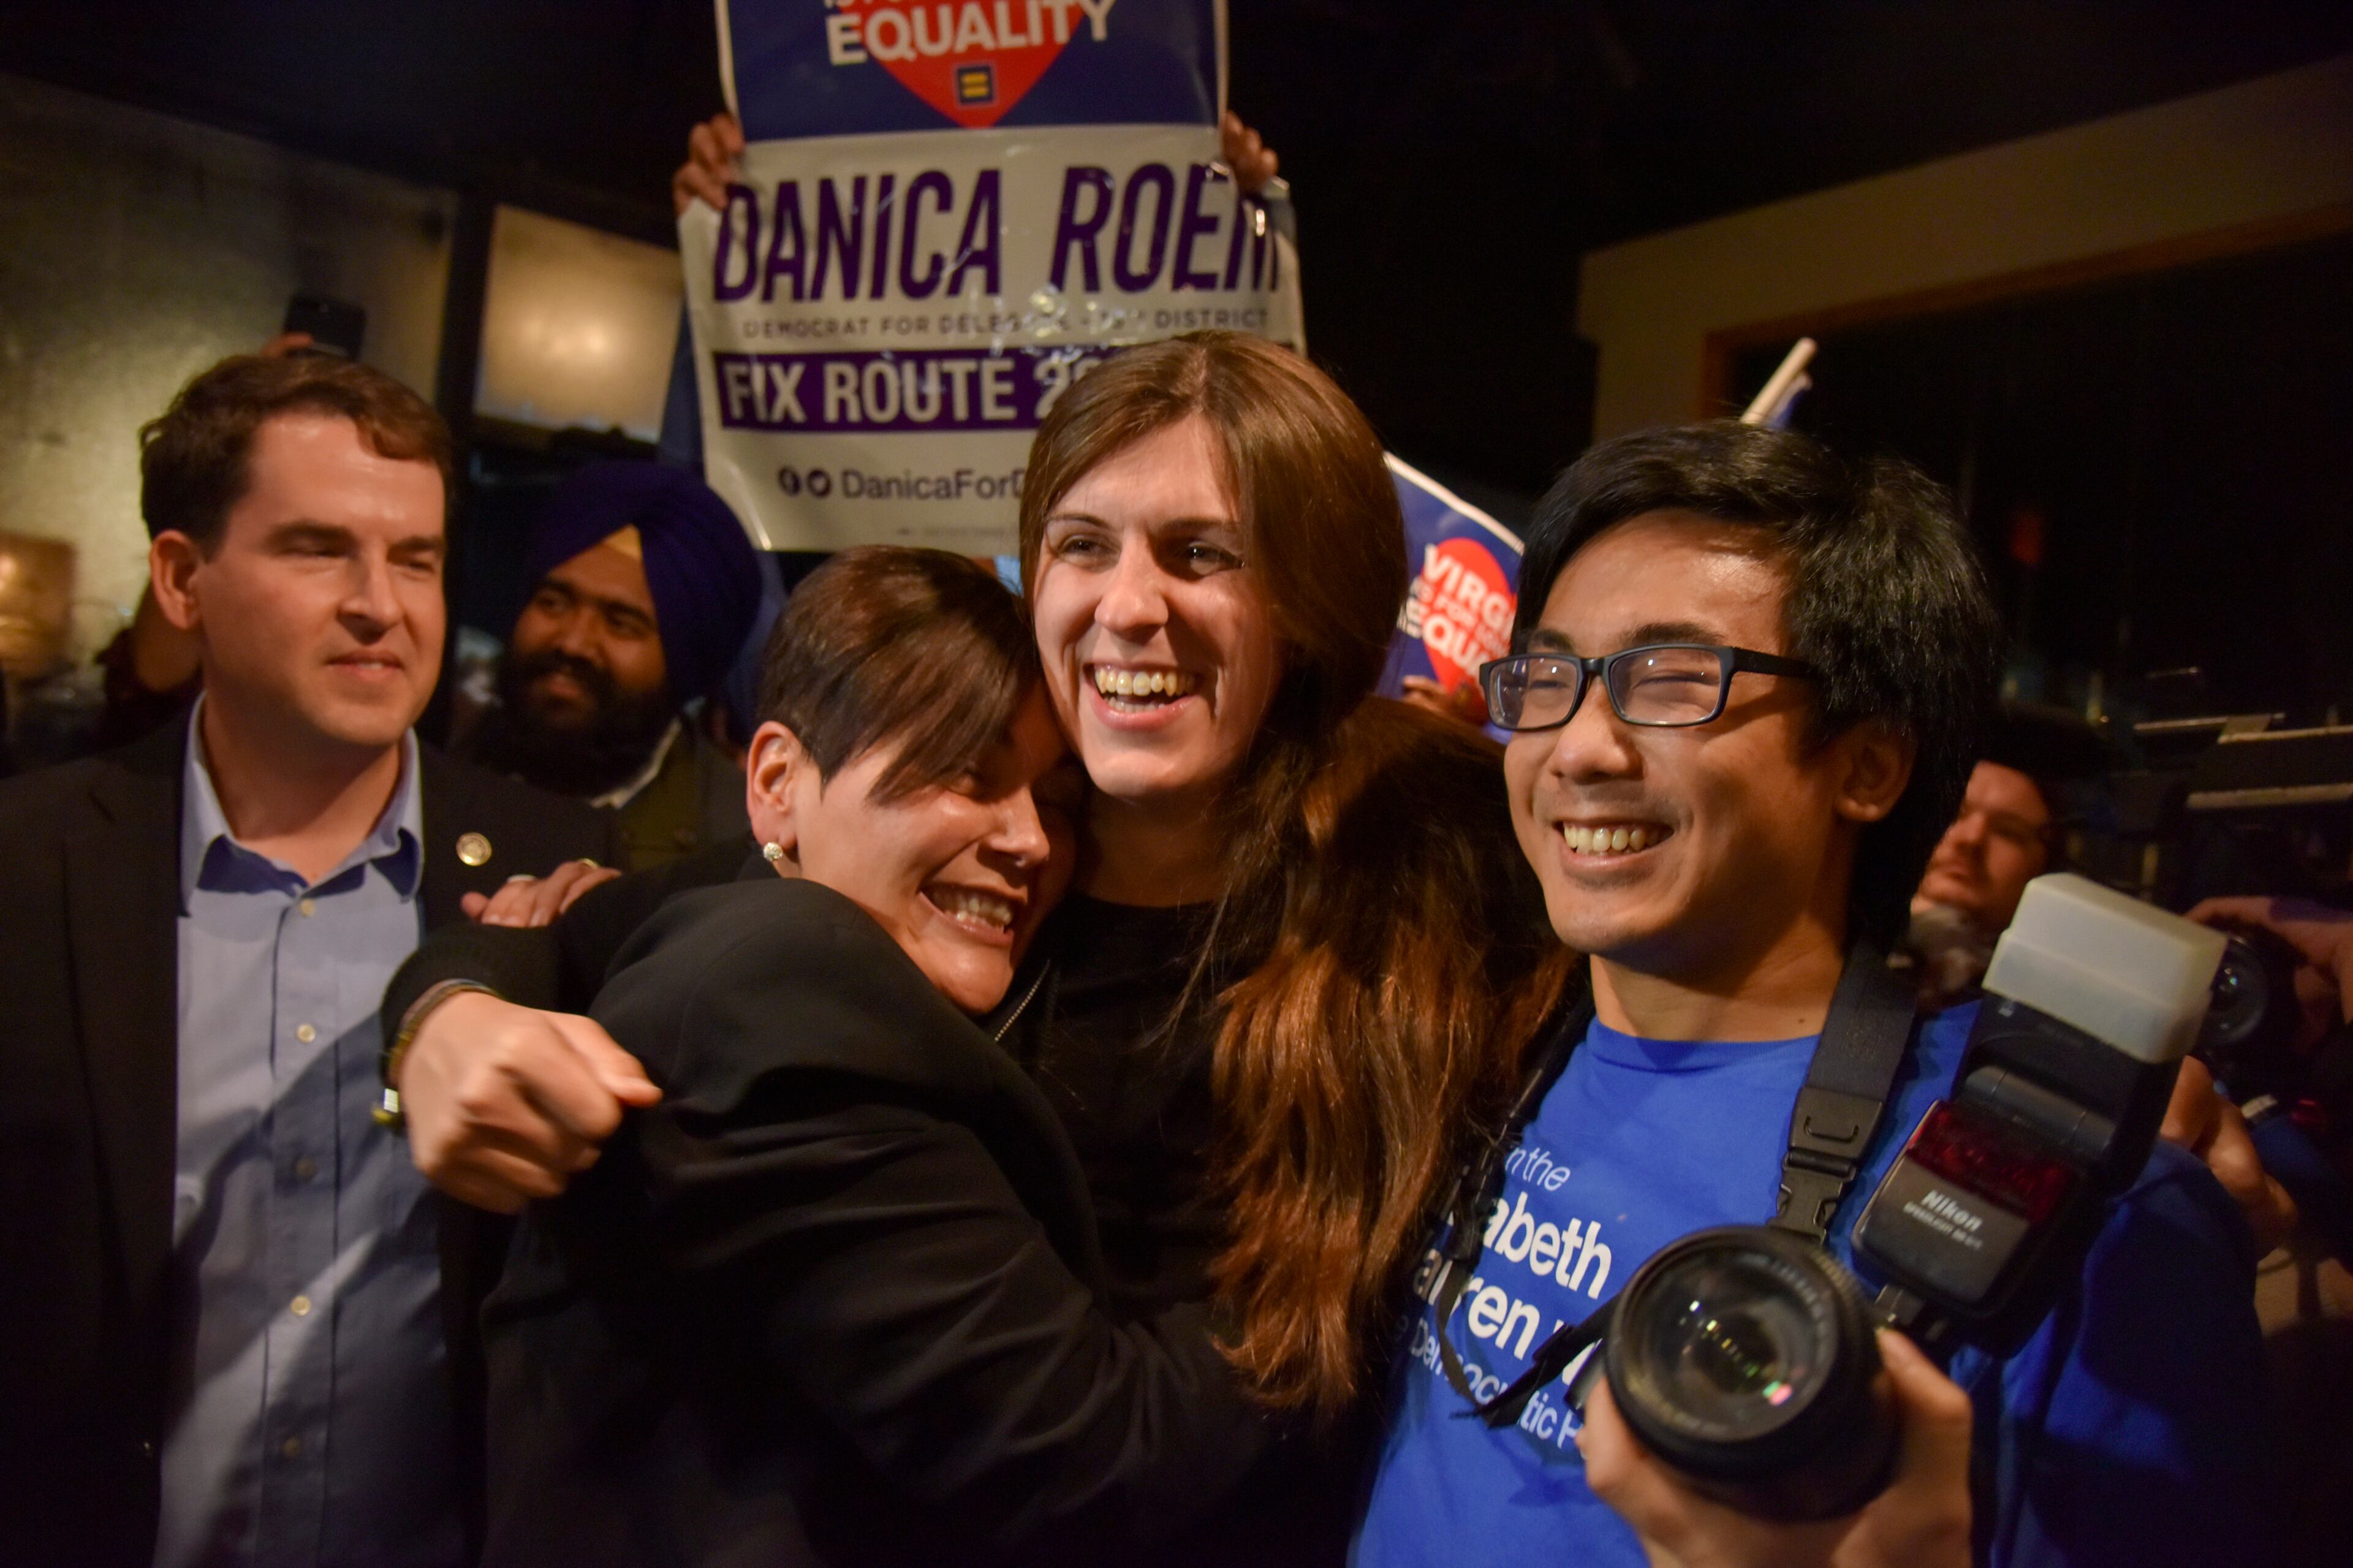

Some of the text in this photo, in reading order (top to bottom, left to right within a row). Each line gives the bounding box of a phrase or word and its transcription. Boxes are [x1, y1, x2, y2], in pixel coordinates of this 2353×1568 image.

[827, 0, 1115, 66] EQUALITY
[714, 169, 1001, 301] DANICA
[743, 317, 870, 339] DEMOCRAT
[880, 313, 931, 336] FOR
[1154, 308, 1268, 330] DISTRICT
[724, 357, 1105, 423] FIX ROUTE 2
[1519, 1146, 1571, 1192] the
[1920, 1189, 1984, 1233] Nikon
